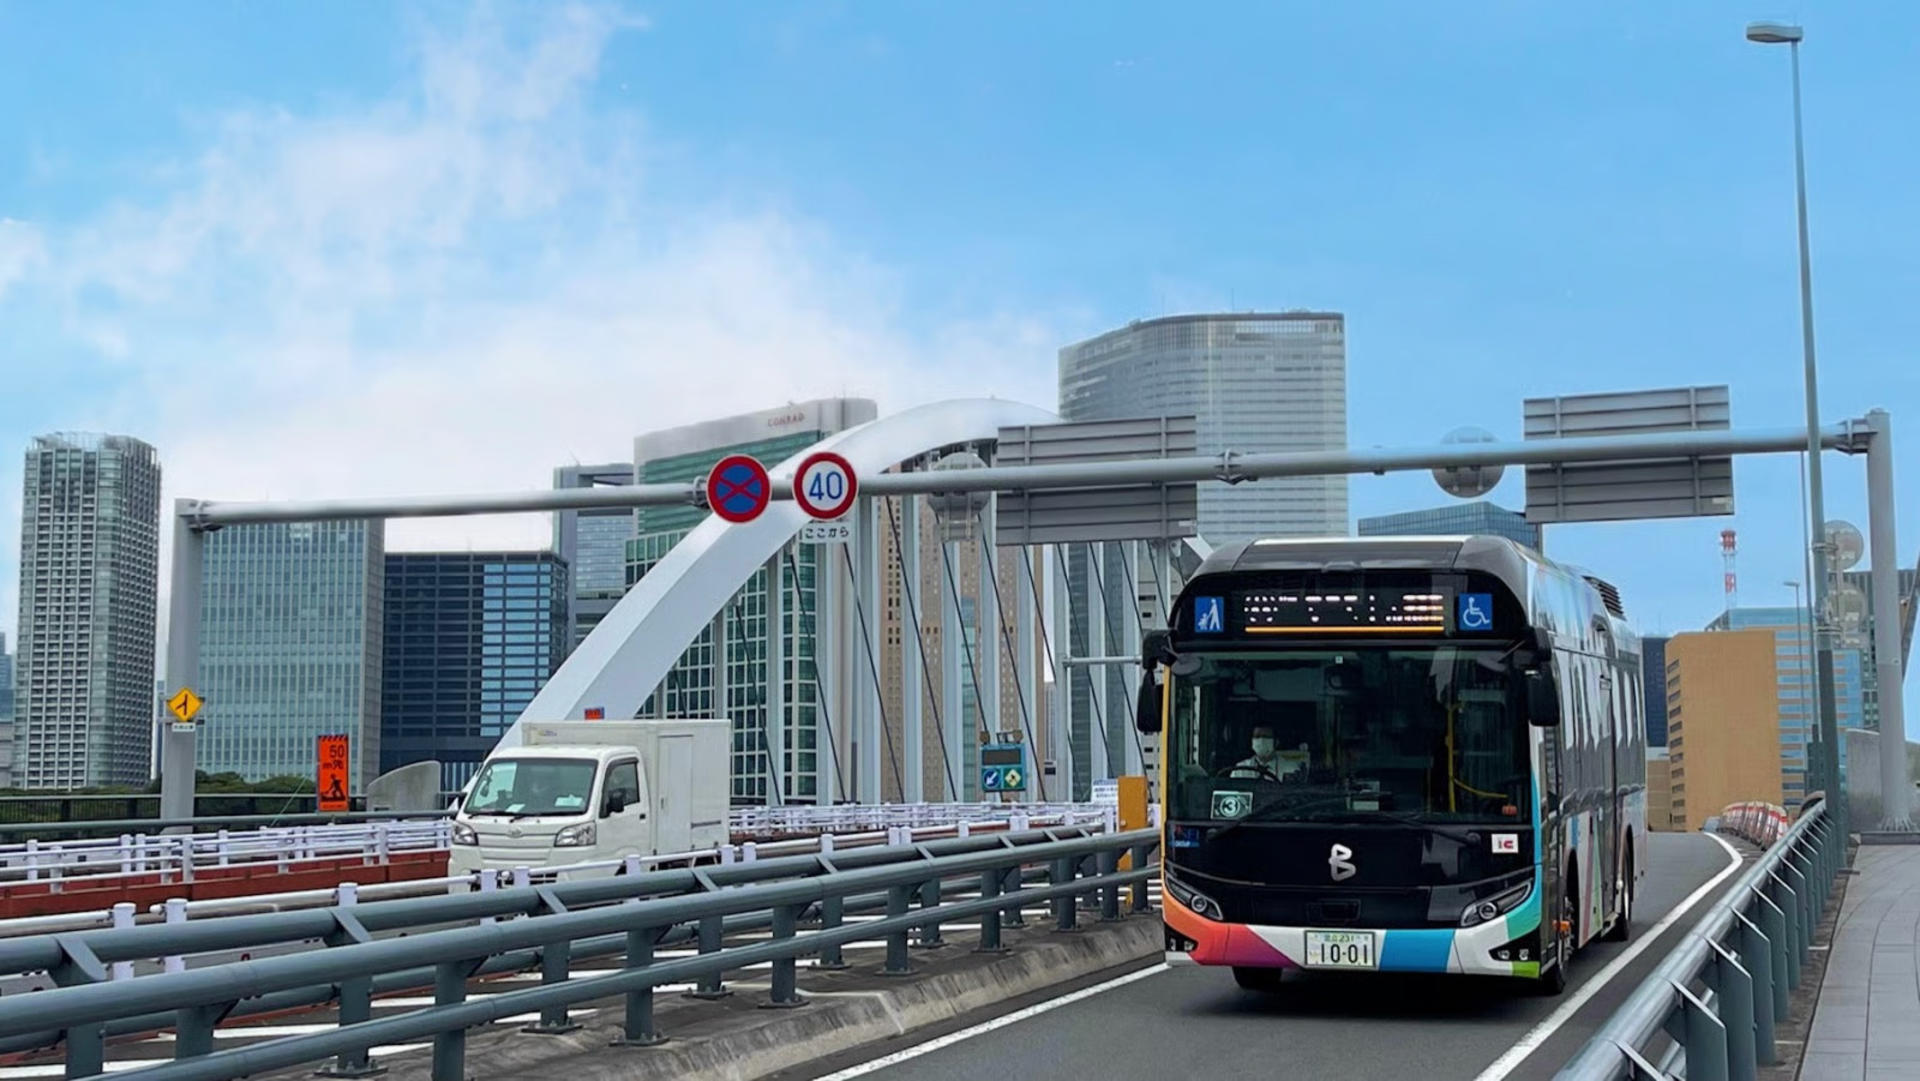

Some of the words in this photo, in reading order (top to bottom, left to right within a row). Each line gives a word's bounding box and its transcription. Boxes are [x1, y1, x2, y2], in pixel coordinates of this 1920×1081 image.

[808, 470, 844, 500] 40
[805, 526, 849, 540] ここから
[329, 744, 345, 758] 50
